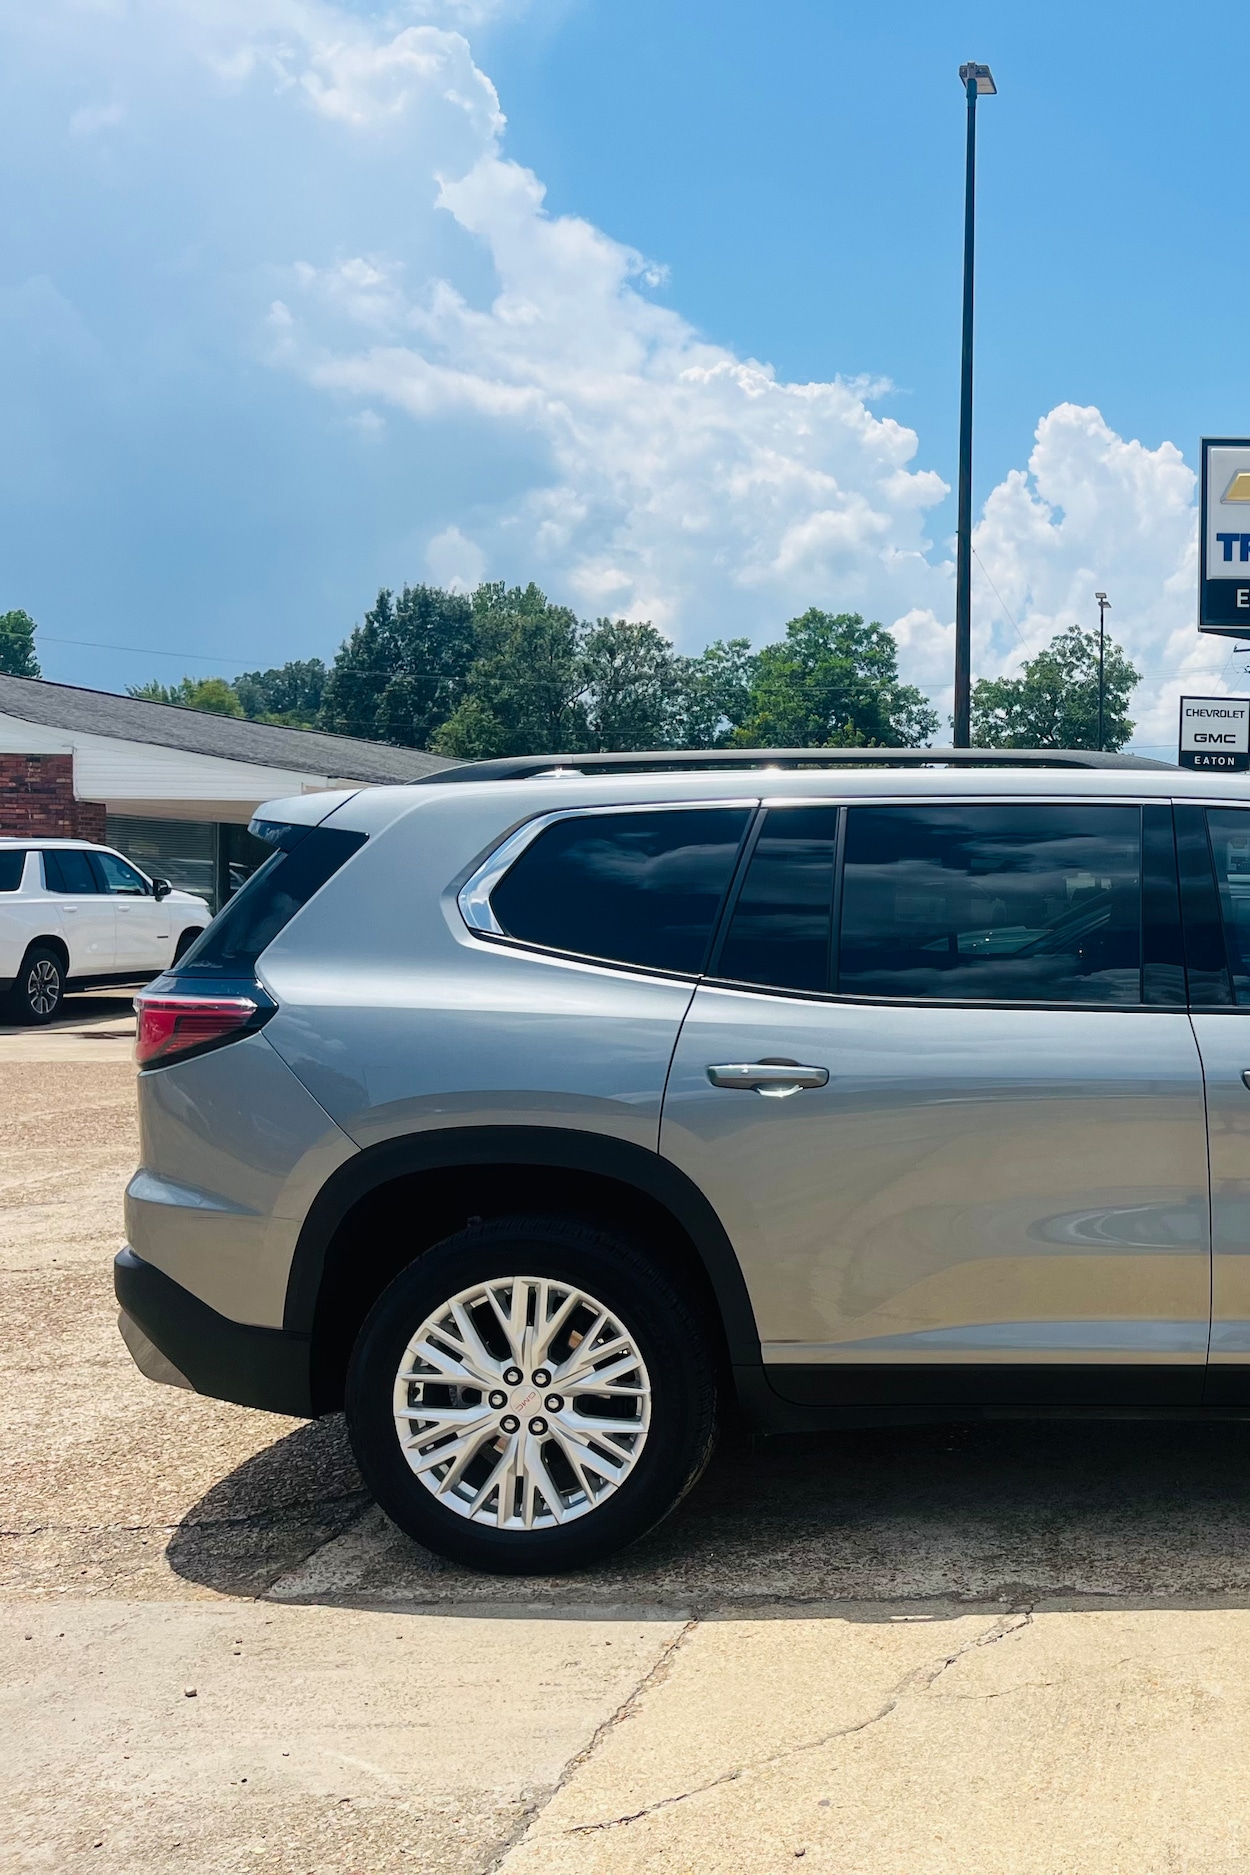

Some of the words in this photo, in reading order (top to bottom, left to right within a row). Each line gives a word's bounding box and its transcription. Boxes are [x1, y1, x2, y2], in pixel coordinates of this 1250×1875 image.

[1186, 708, 1245, 719] CHEVROLET
[1194, 733, 1236, 744] GMC
[1194, 755, 1235, 766] EATON
[515, 1391, 537, 1412] GMC
